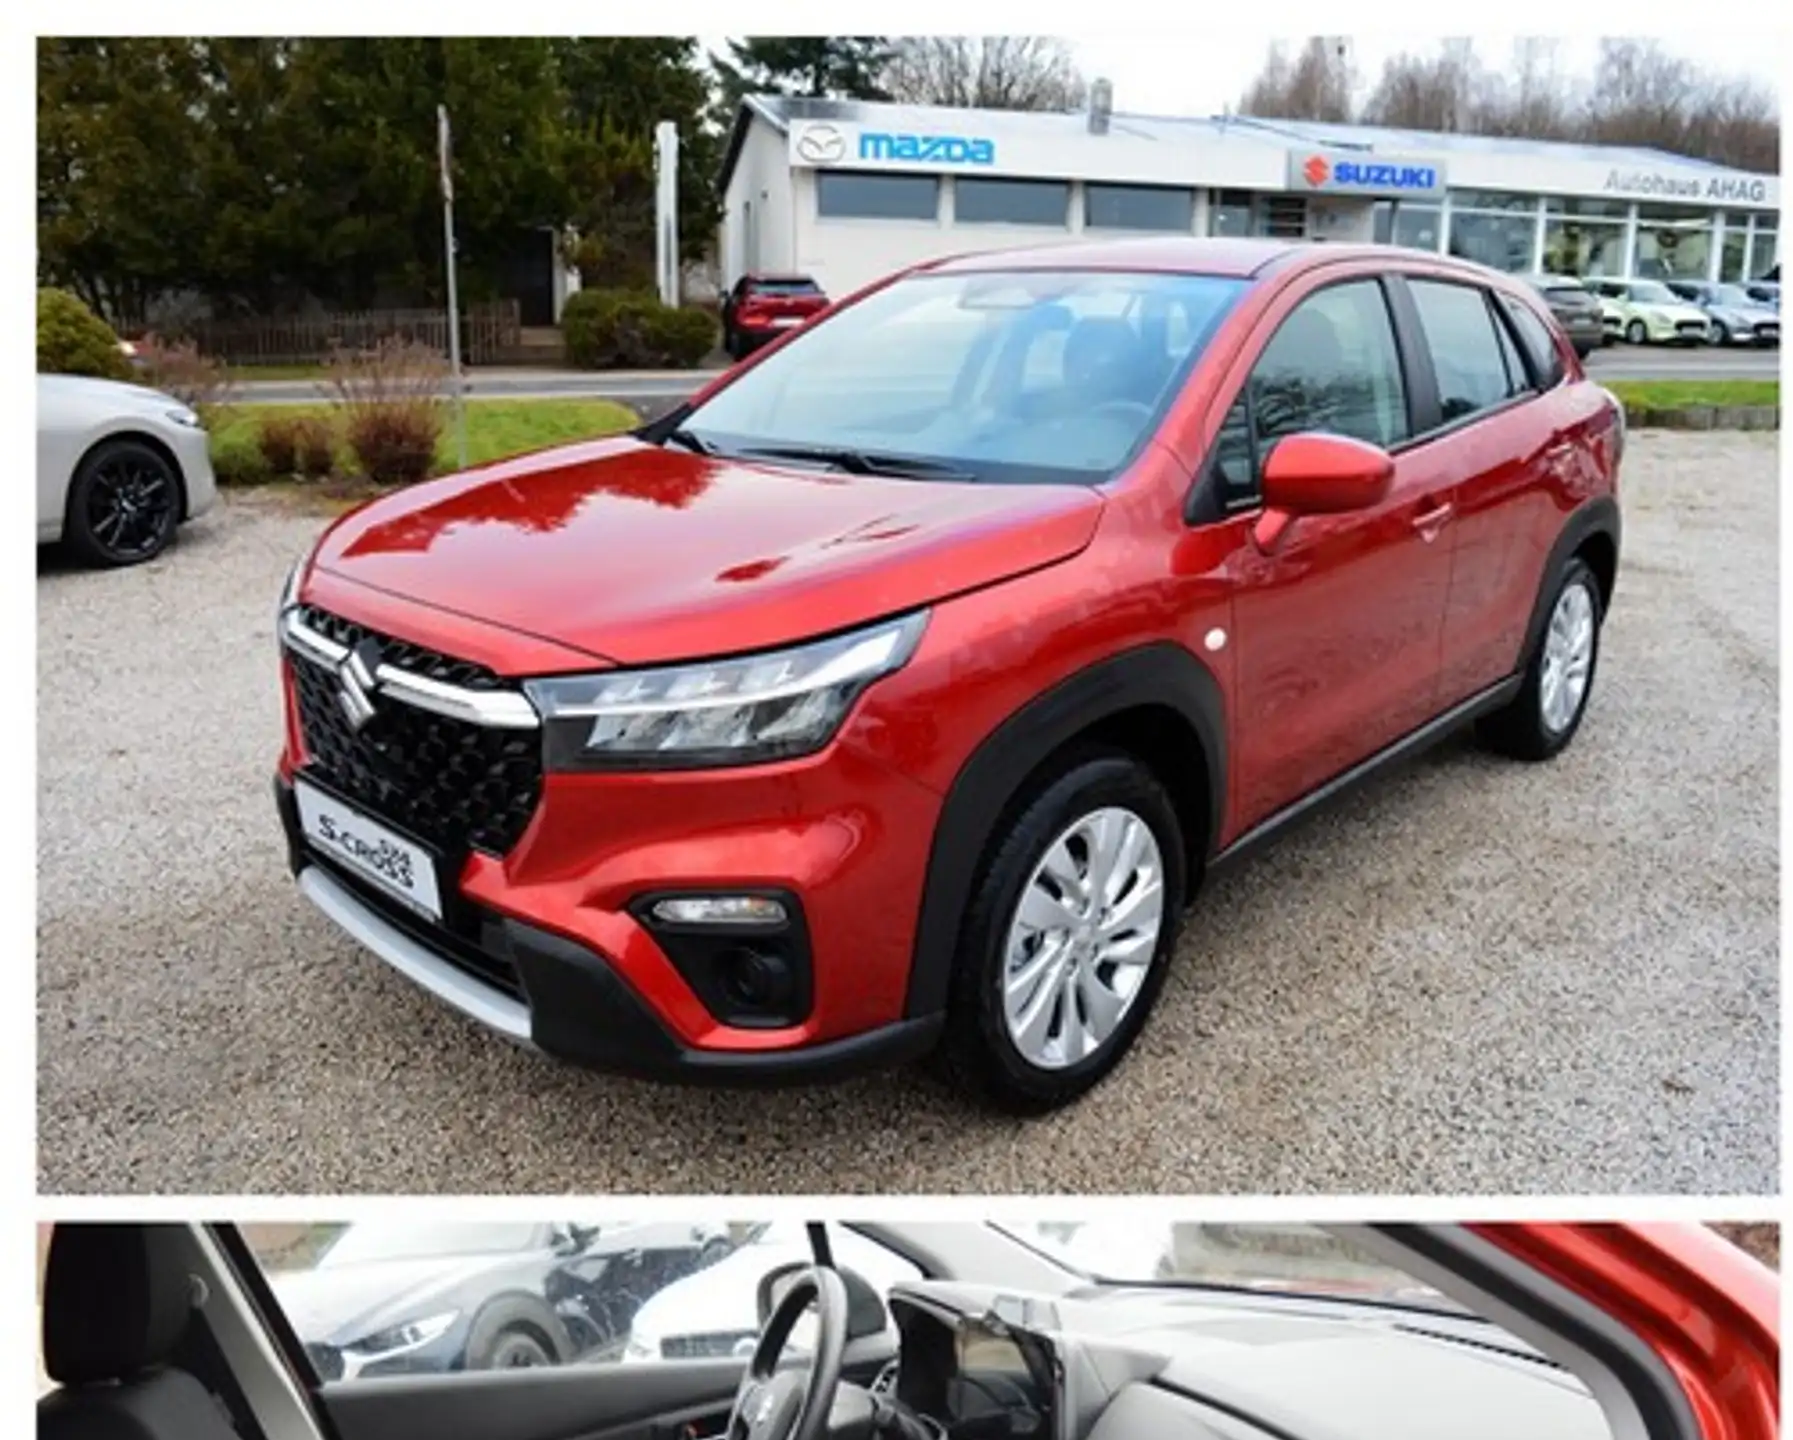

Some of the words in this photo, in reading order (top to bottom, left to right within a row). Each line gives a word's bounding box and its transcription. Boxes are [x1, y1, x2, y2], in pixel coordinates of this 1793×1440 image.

[1334, 162, 1436, 188] SUZUKI
[1604, 170, 1699, 196] Autohaus
[1706, 178, 1766, 201] AHAG
